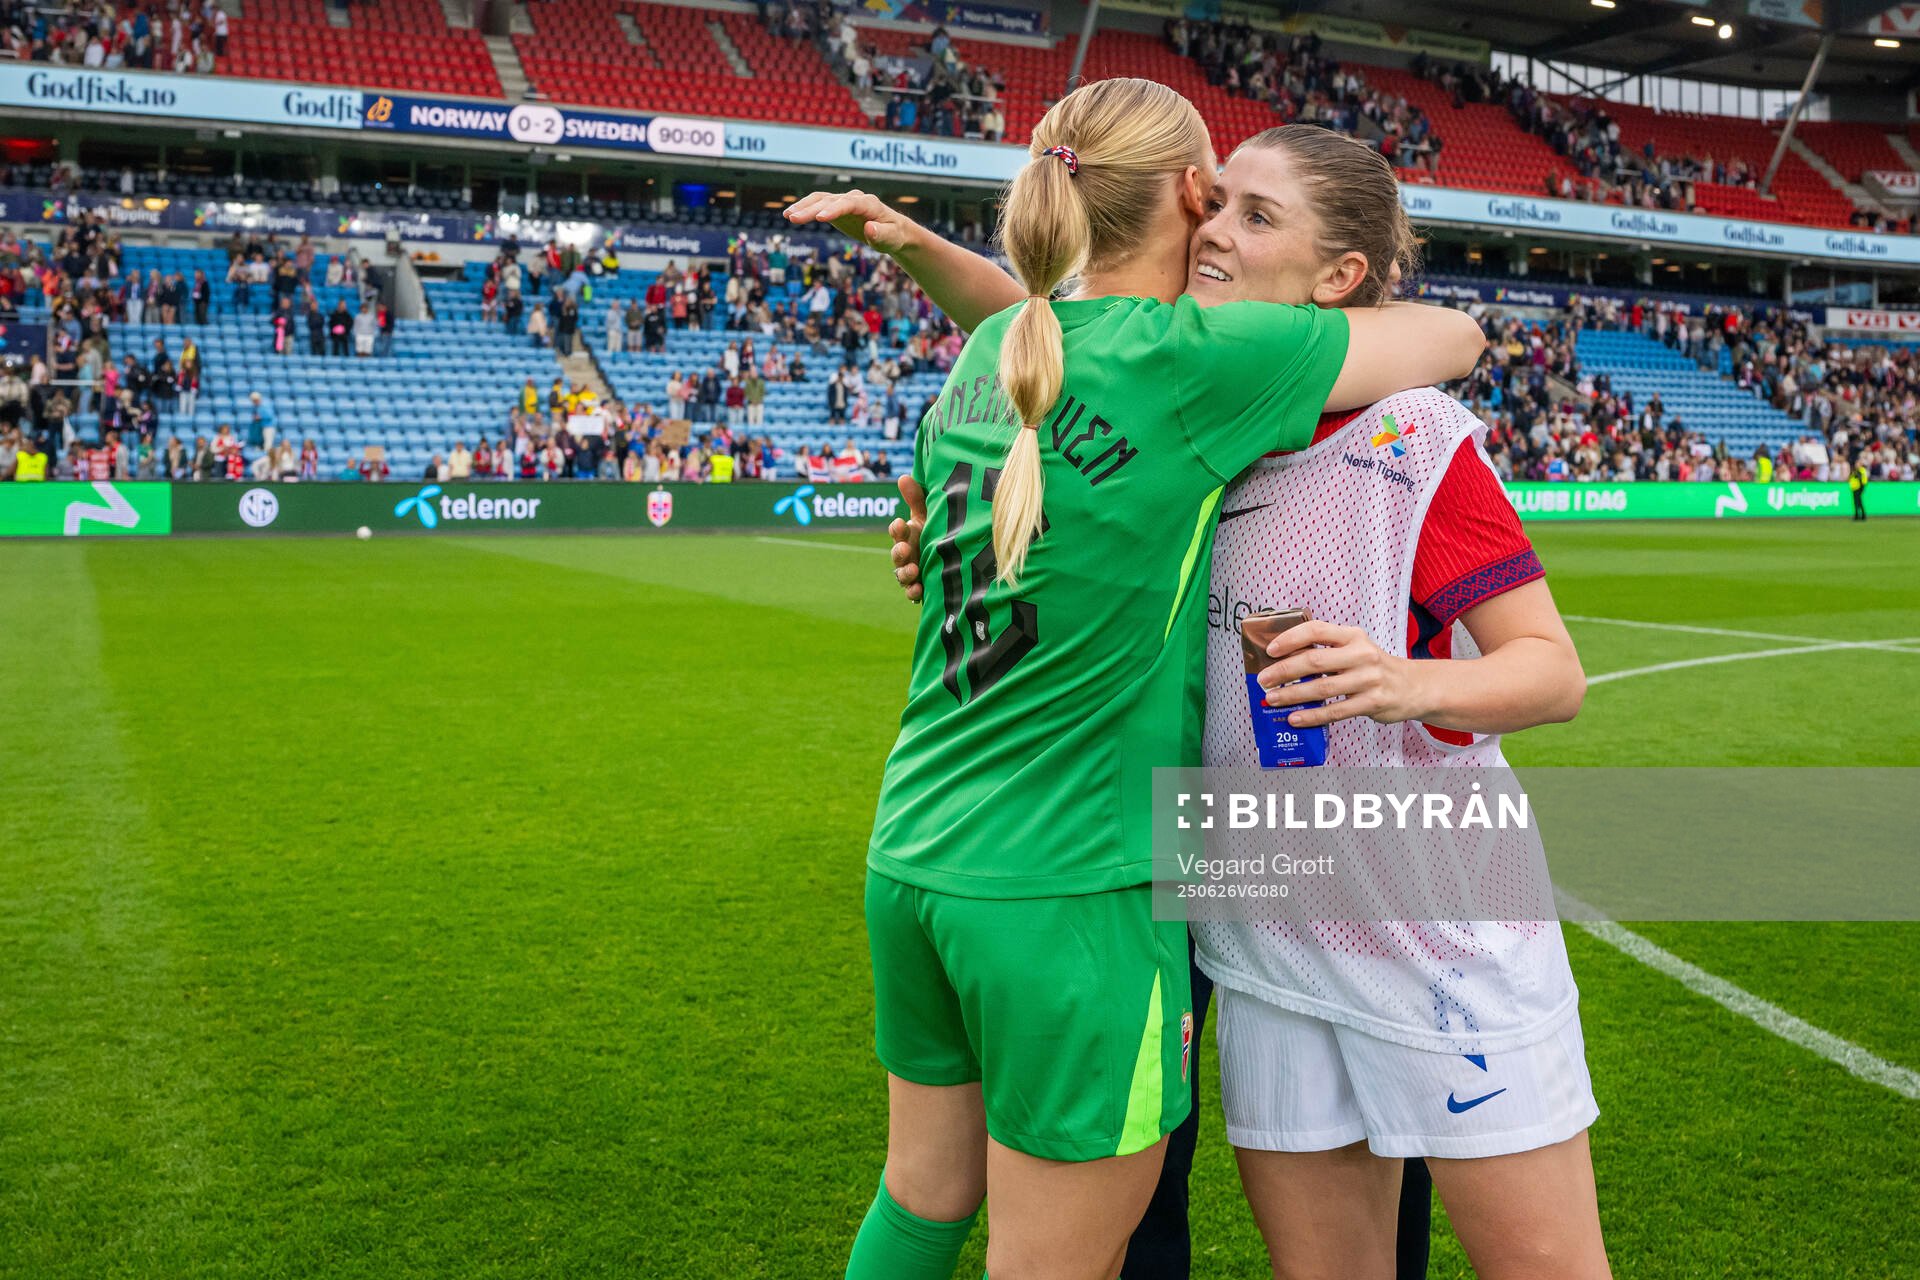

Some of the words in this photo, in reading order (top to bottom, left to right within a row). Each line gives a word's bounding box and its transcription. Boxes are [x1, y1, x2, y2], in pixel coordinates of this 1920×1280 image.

[27, 72, 176, 109] Godfisk.no
[410, 105, 506, 135] NORWAY
[566, 118, 645, 143] SWEDEN
[659, 128, 715, 147] 90:00
[850, 138, 958, 170] Godfisk.no
[1487, 199, 1561, 224] Godfisk.no
[1611, 211, 1678, 235] Godfisk.no
[623, 233, 657, 247] Norsk
[657, 234, 701, 253] Tipping
[1723, 223, 1784, 245] Godfisk.no
[1825, 234, 1887, 256] Godfisk.no
[1342, 452, 1375, 470] Norsk
[1376, 459, 1416, 493] Tipping
[440, 494, 541, 520] telenor
[812, 493, 899, 517] telenor
[1584, 489, 1627, 512] DAG
[1276, 731, 1299, 743] 20g
